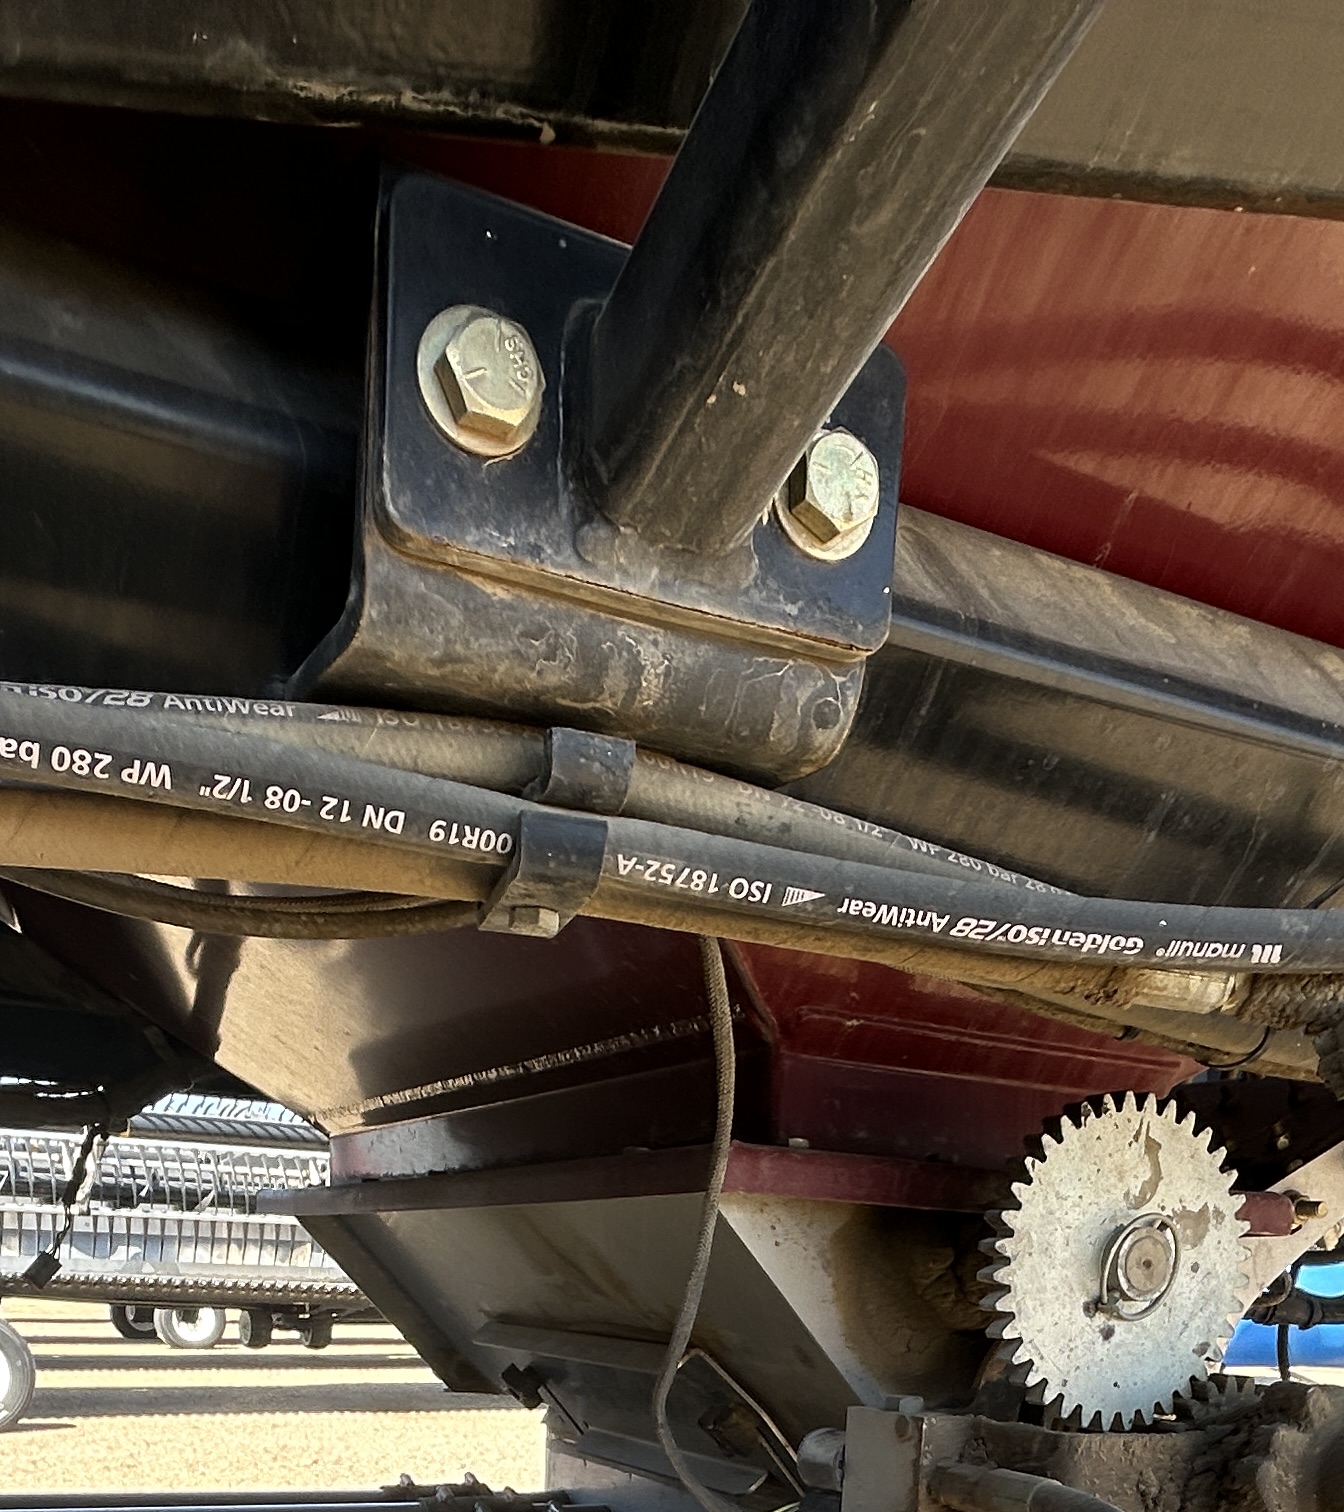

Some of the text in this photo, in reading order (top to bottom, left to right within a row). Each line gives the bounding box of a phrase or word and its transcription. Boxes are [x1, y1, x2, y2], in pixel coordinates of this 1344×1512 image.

[163, 691, 297, 718] AntiWear
[50, 745, 114, 780] 280
[120, 759, 173, 791] WP
[199, 774, 253, 804] 1/2"
[263, 785, 312, 814] -08
[319, 795, 353, 824] 12
[361, 803, 406, 836] DN
[617, 853, 720, 894] 18752-A
[728, 876, 774, 905] ISO
[837, 898, 951, 934] AntiWear
